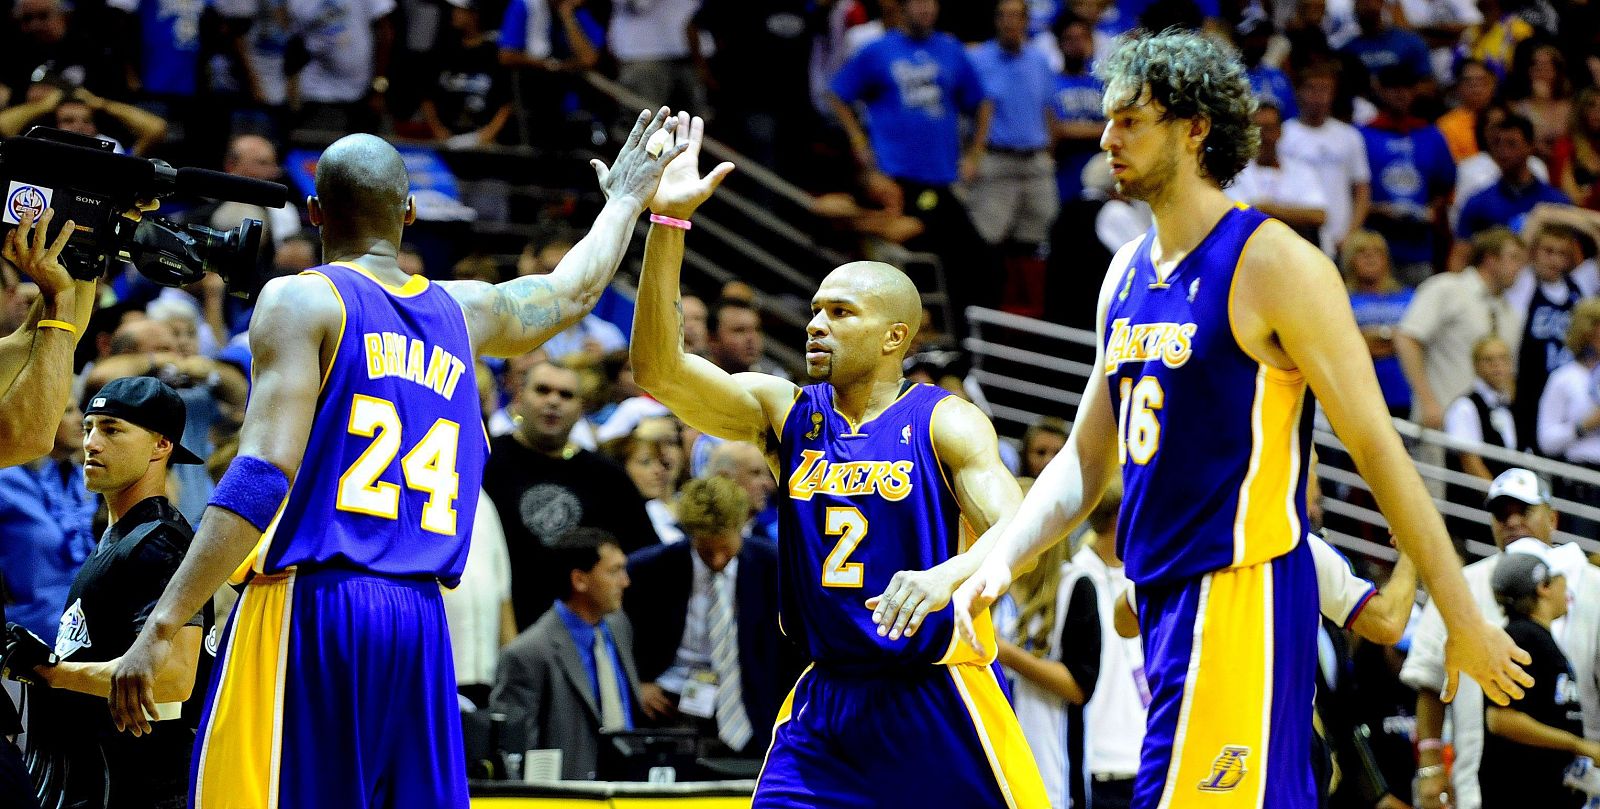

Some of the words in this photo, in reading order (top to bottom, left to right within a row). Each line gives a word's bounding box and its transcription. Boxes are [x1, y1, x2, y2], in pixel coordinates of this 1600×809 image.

[75, 195, 101, 206] SONY
[159, 257, 182, 270] Canon
[363, 331, 466, 401] BRYANT
[1104, 317, 1198, 375] LAKERS
[1117, 376, 1165, 465] 16
[336, 393, 460, 536] 24
[788, 449, 915, 502] LAKERS
[821, 506, 869, 588] 2
